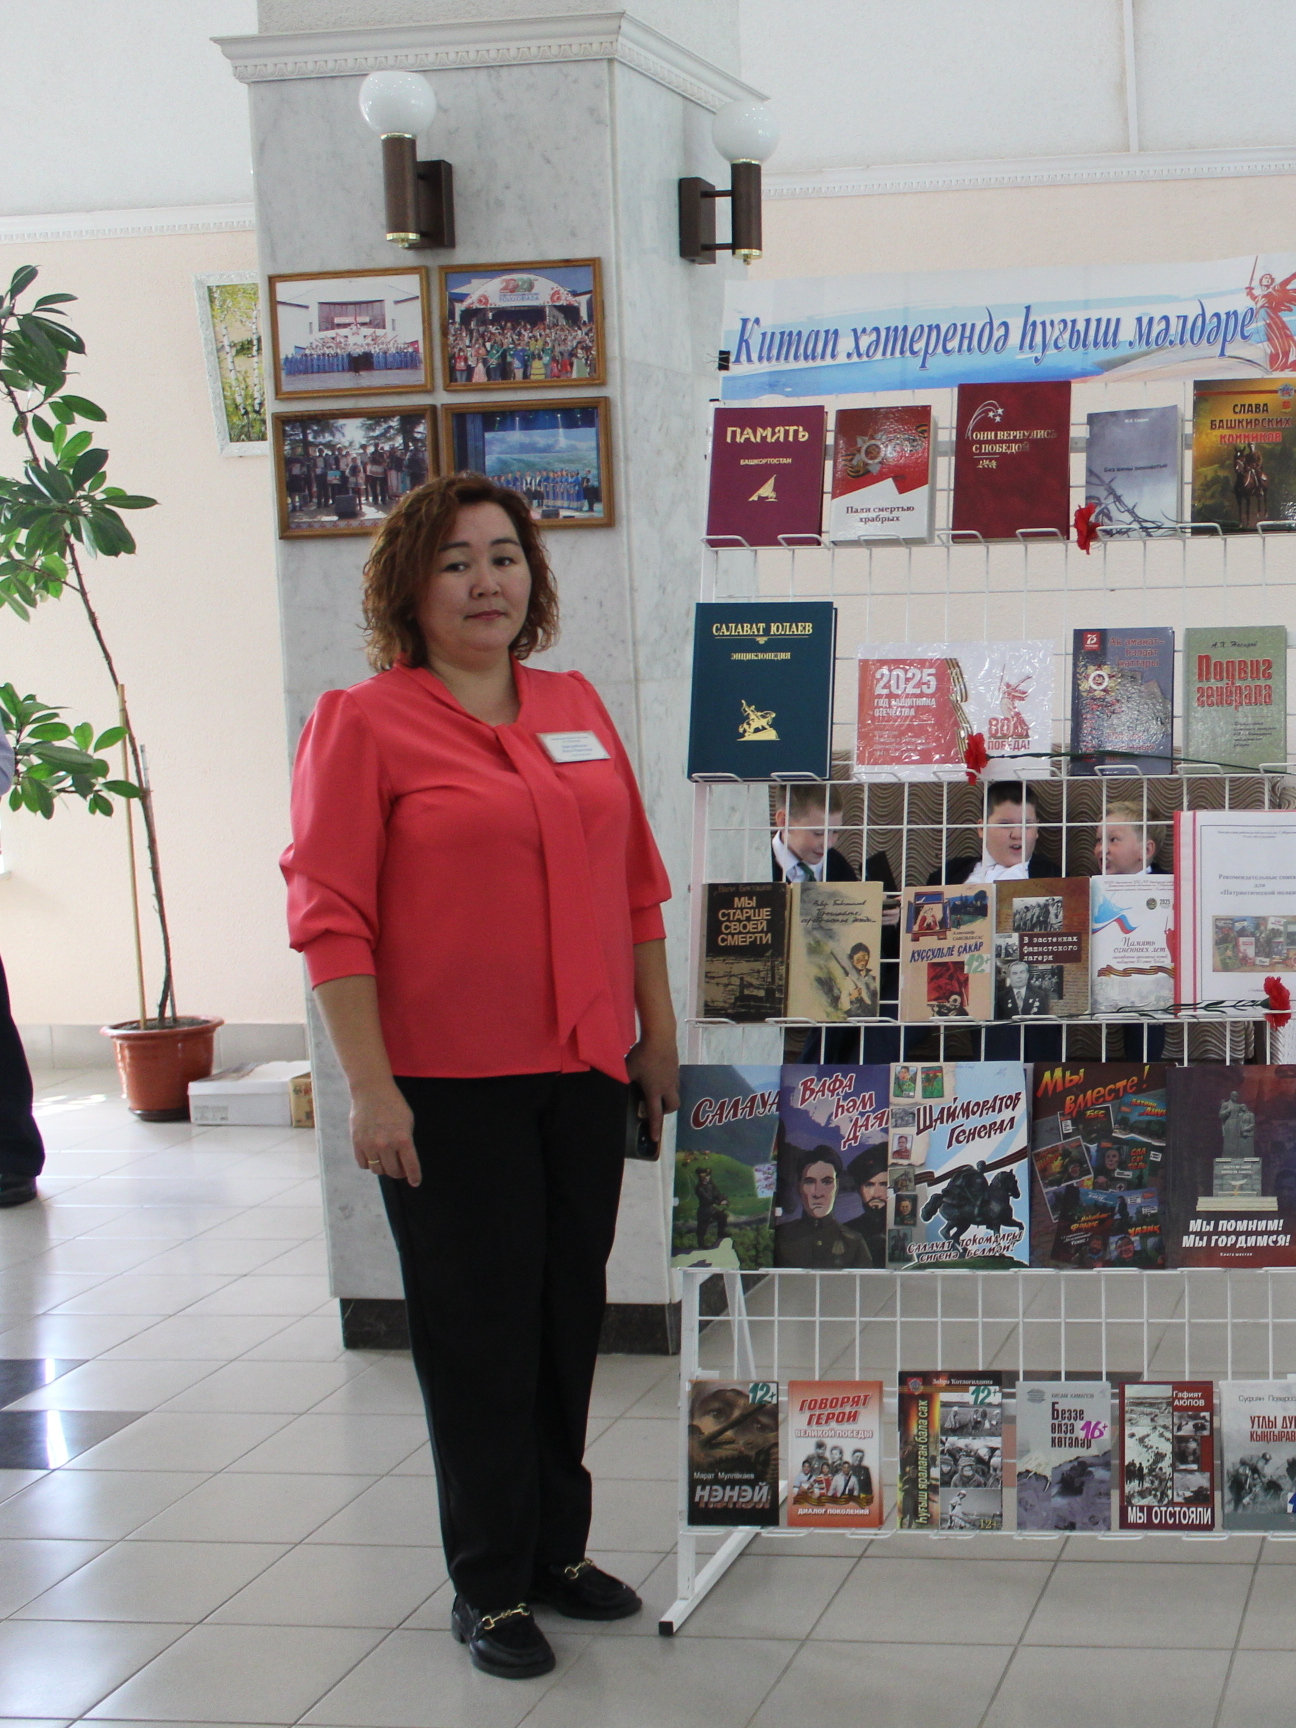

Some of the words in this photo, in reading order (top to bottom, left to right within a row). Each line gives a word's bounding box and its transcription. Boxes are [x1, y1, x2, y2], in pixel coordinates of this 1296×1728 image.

[733, 317, 838, 366] Китап
[847, 308, 1009, 371] хәтерендә
[1019, 305, 1121, 362] һуғыш
[1130, 300, 1257, 358] мәлдәре
[1233, 403, 1268, 414] СЛАВА
[1210, 417, 1291, 430] БАШКИРСКИХ
[726, 426, 809, 443] ПАМЯТЬ
[973, 431, 995, 440] ОНИ
[1220, 432, 1282, 443] КОННИКОВ
[982, 442, 1029, 454] ПОБЕДОЙ
[740, 457, 791, 465] БАШКОРТОСТАН
[846, 506, 871, 514] Пали
[873, 505, 914, 515] смертью
[859, 515, 900, 523] храбрых
[712, 623, 765, 635] САЛАВАТ
[770, 622, 813, 635] ЮЛАЕВ
[731, 652, 791, 660] ЭНЦИКЛОПЕДИЯ
[1198, 654, 1272, 685] Подвиг
[875, 668, 936, 695] 2025
[874, 698, 889, 707] ГОД
[1197, 684, 1272, 711] генерала
[874, 708, 915, 716] ОТЕЧЕСТВА
[734, 897, 756, 908] МЫ
[719, 908, 771, 920] СТАРШЕ
[722, 920, 766, 933] СВОЕЙ
[718, 933, 771, 946] СМЕРТИ
[1121, 937, 1156, 947] Память
[916, 1092, 1022, 1136] ШАЙМОРАТОВ
[1218, 1219, 1284, 1231] ПОМНИМ!
[1210, 1235, 1291, 1248] ГОРДИМСЯ!
[750, 1383, 776, 1404] 12+
[1173, 1391, 1202, 1400] Гафият
[799, 1393, 870, 1412] ГОВОРЯТ
[806, 1411, 859, 1426] ГЕРОИ
[1250, 1416, 1277, 1429] УТЛЫ
[795, 1429, 835, 1438] ВЕЛИКОЙ
[836, 1429, 873, 1439] ПОБЕДЫ
[915, 1420, 928, 1443] бала
[1080, 1421, 1108, 1439] 16+
[695, 1482, 769, 1503] НЭНЭЙ
[827, 1507, 870, 1515] ПОКОЛЕНИЙ
[1127, 1507, 1147, 1524] МЫ
[1152, 1506, 1211, 1525] ОТСТОЯЛИ
